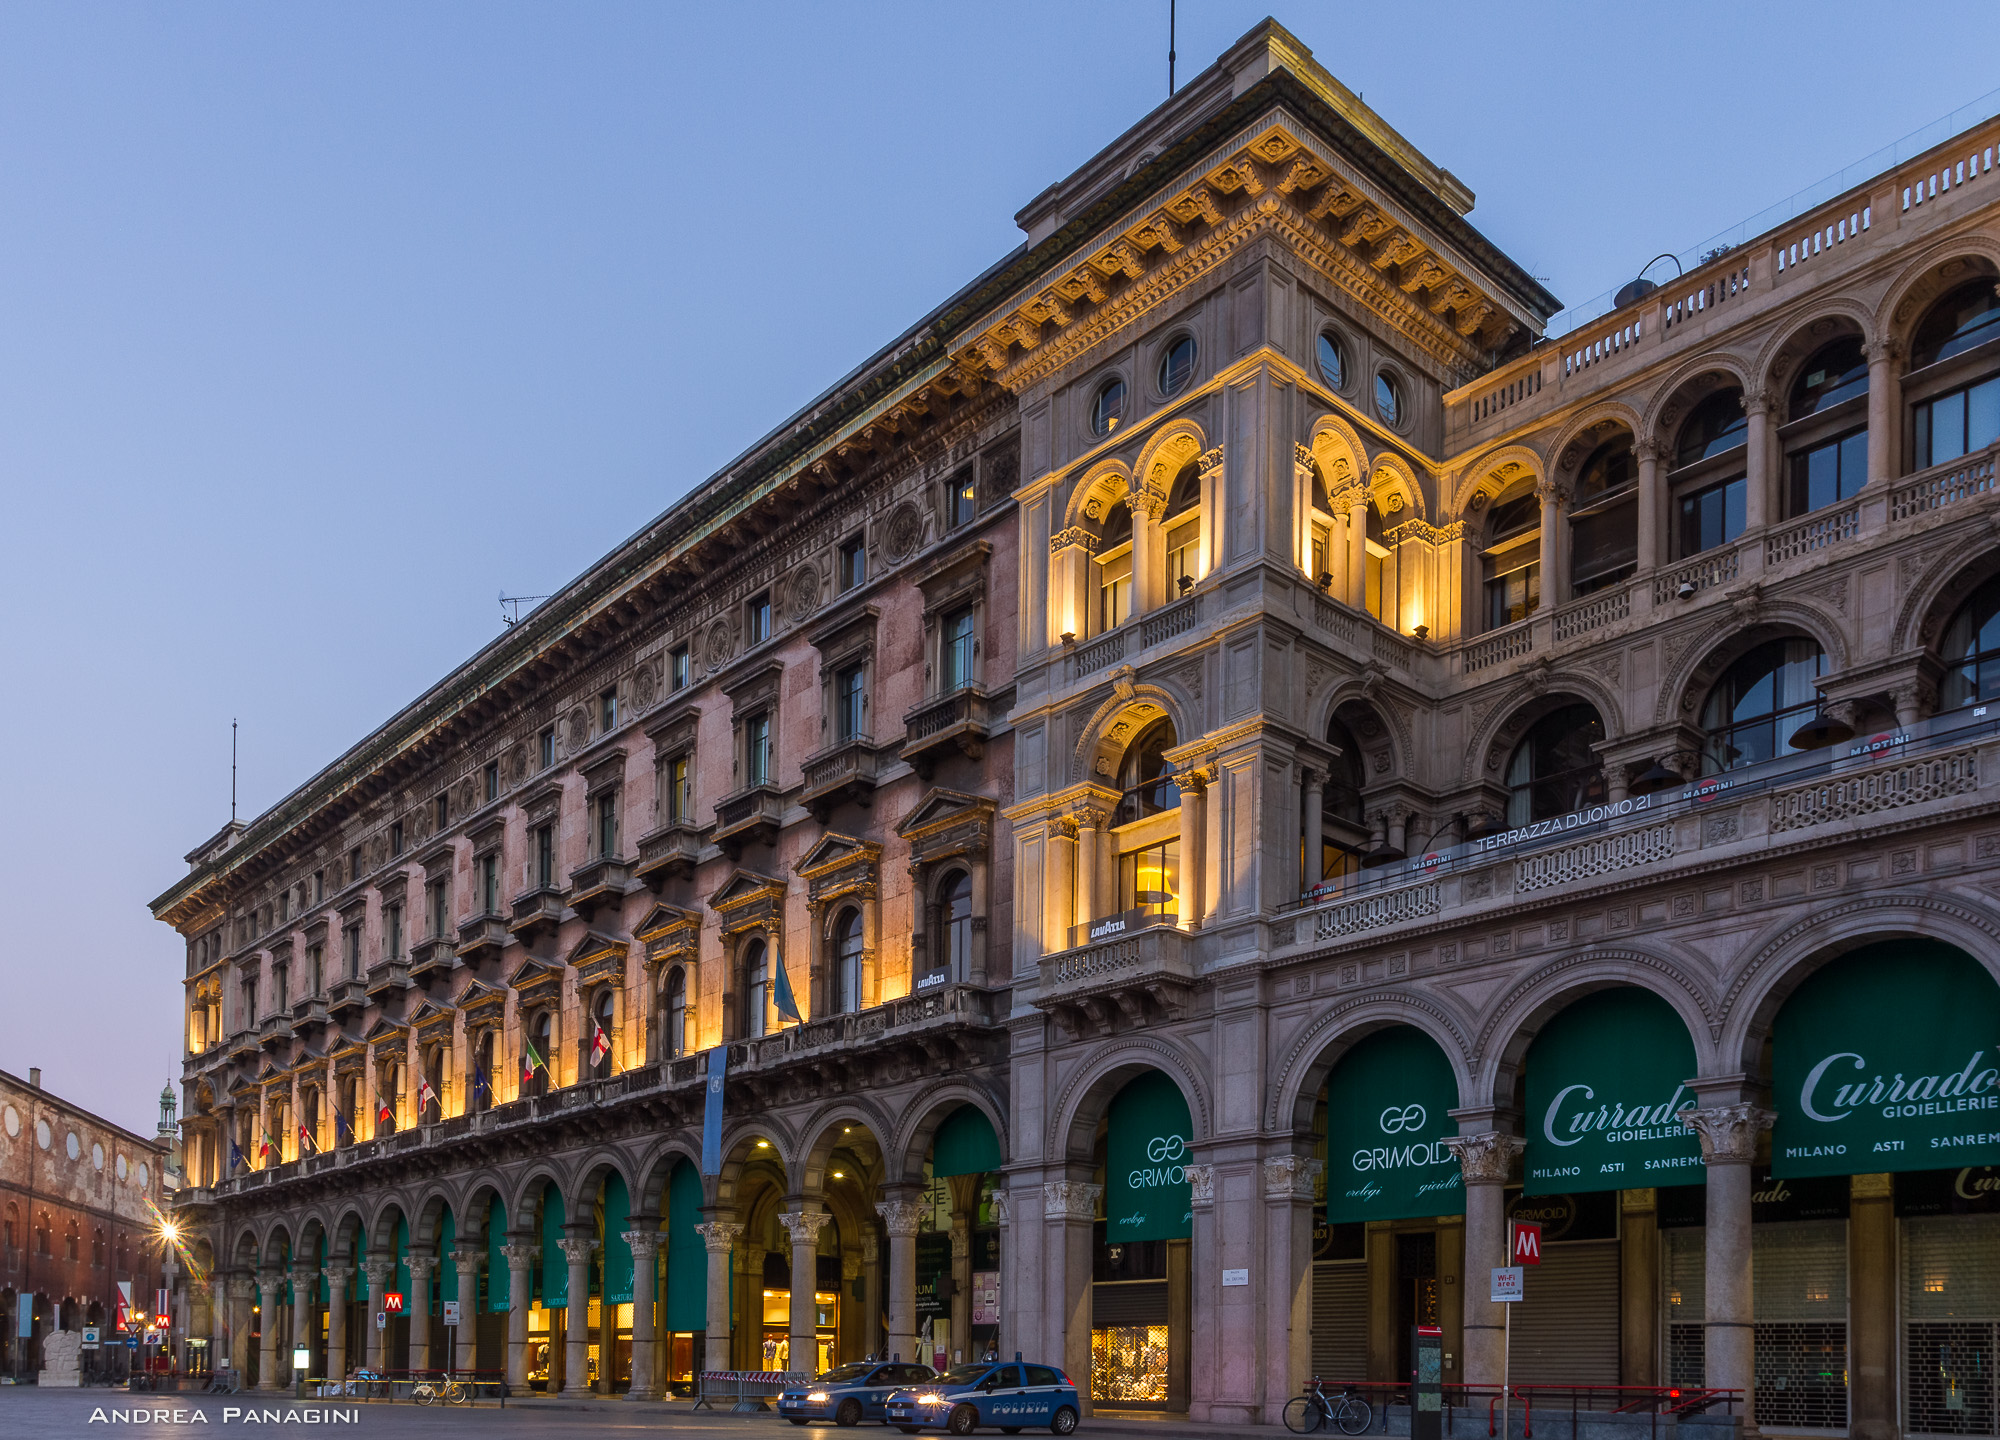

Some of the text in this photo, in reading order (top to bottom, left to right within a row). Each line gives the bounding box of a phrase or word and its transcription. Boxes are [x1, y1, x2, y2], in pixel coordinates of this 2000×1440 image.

[1850, 734, 1910, 757] MARTINI
[1682, 780, 1734, 800] MARTINI
[1476, 793, 1652, 852] TERRAZZA DUOMO 21
[1412, 854, 1451, 871] MARTINI
[1301, 884, 1336, 900] MARTINI
[1090, 920, 1126, 939] LAVAZZA
[917, 973, 945, 989] LAVAZZA
[1800, 1051, 2000, 1122] Currado
[1544, 1084, 1697, 1146] Currado
[1882, 1095, 1999, 1118] GIOIELLERIE
[1352, 1141, 1457, 1171] GRIMOLD
[1786, 1144, 1847, 1158] MILANO
[1873, 1140, 1905, 1153] ASTI
[1532, 1166, 1581, 1178] MILANO
[1600, 1162, 1625, 1173] ASTI
[1345, 1180, 1383, 1202] orologi
[1516, 1231, 1539, 1257] M
[385, 1296, 402, 1309] M
[610, 1292, 634, 1302] SARTORI
[156, 1317, 170, 1327] M
[992, 1401, 1049, 1415] POLIZIA
